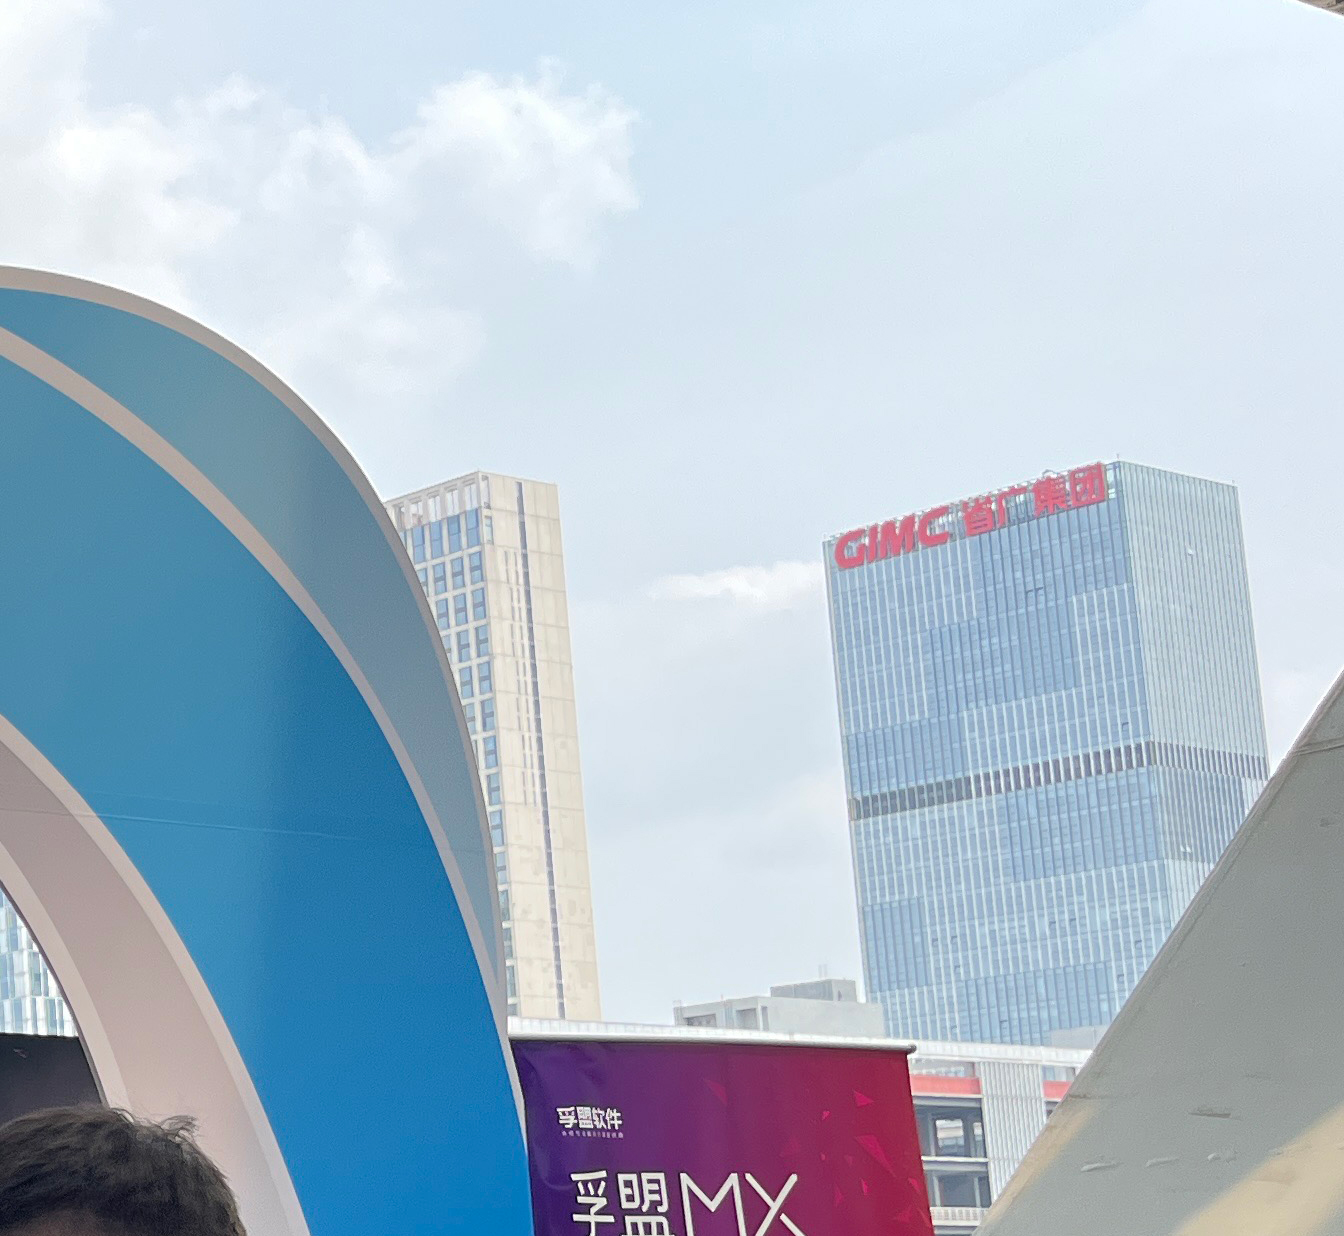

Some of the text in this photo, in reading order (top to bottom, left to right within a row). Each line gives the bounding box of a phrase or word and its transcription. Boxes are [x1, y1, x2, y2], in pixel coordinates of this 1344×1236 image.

[834, 461, 1106, 570] GIMC 省广集团
[556, 1106, 623, 1130] 孚盟软件
